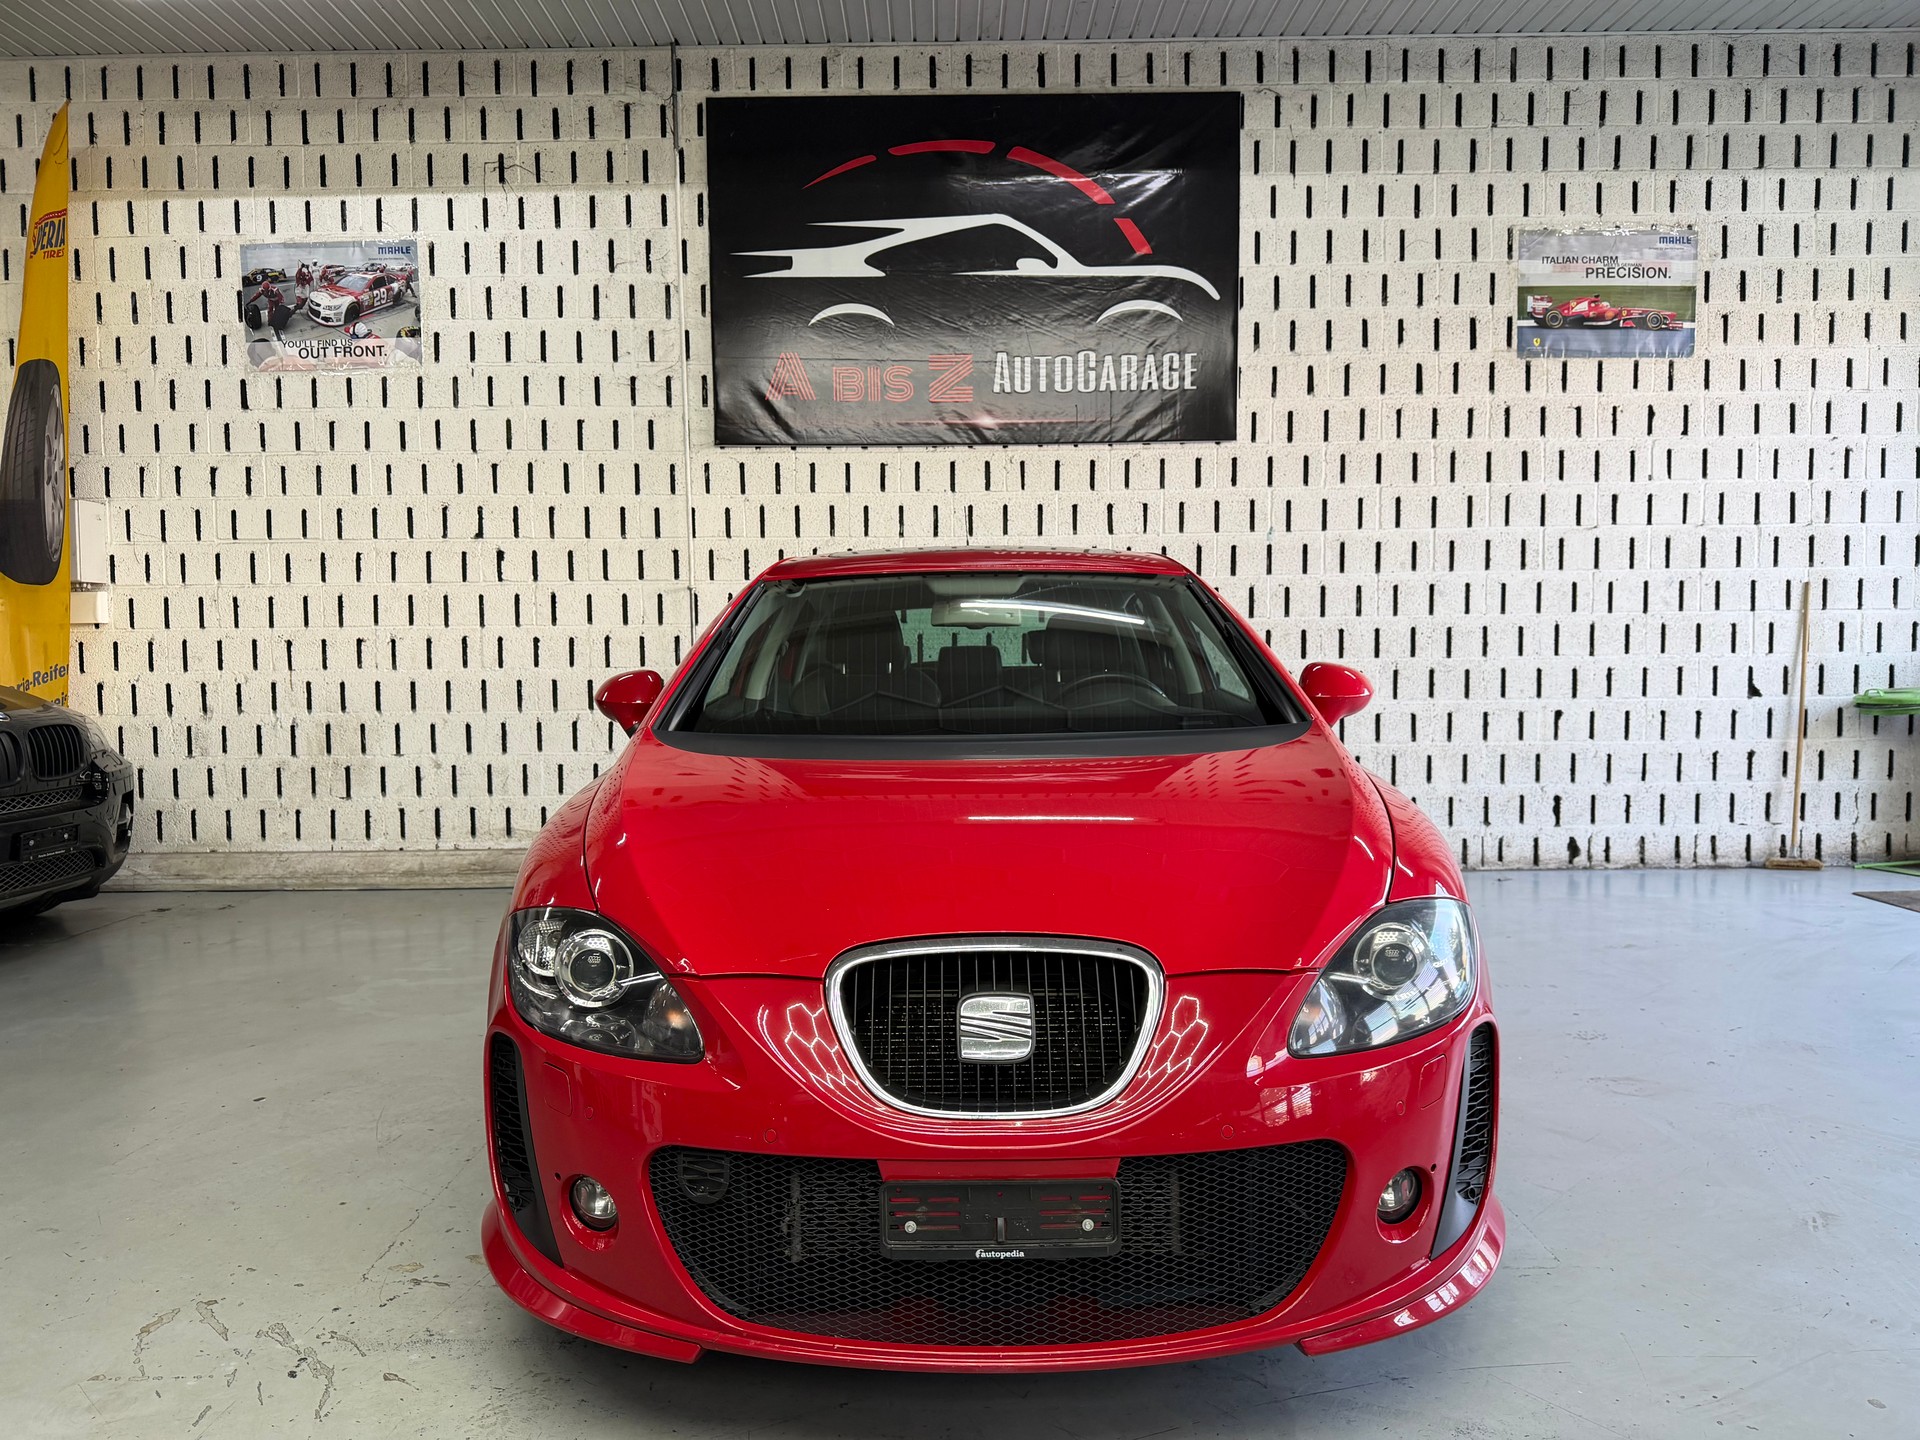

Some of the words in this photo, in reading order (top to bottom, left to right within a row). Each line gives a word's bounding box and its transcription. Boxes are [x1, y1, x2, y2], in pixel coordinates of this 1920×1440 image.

[1659, 236, 1692, 245] MAHLE
[43, 248, 65, 260] TIRES
[377, 246, 411, 255] MAHLE
[1541, 256, 1579, 264] ITALIAN
[1581, 256, 1619, 264] CHARM
[1585, 267, 1672, 279] PRECISION.
[373, 288, 388, 307] 29
[282, 340, 316, 349] YOU'LL
[317, 339, 338, 348] FIND
[340, 338, 354, 347] US
[298, 346, 329, 359] OUT
[333, 345, 388, 358] FRONT.
[765, 352, 817, 401] A
[832, 365, 915, 402] BIS
[928, 353, 974, 403] Z
[992, 350, 1199, 394] AUTOGARAGE
